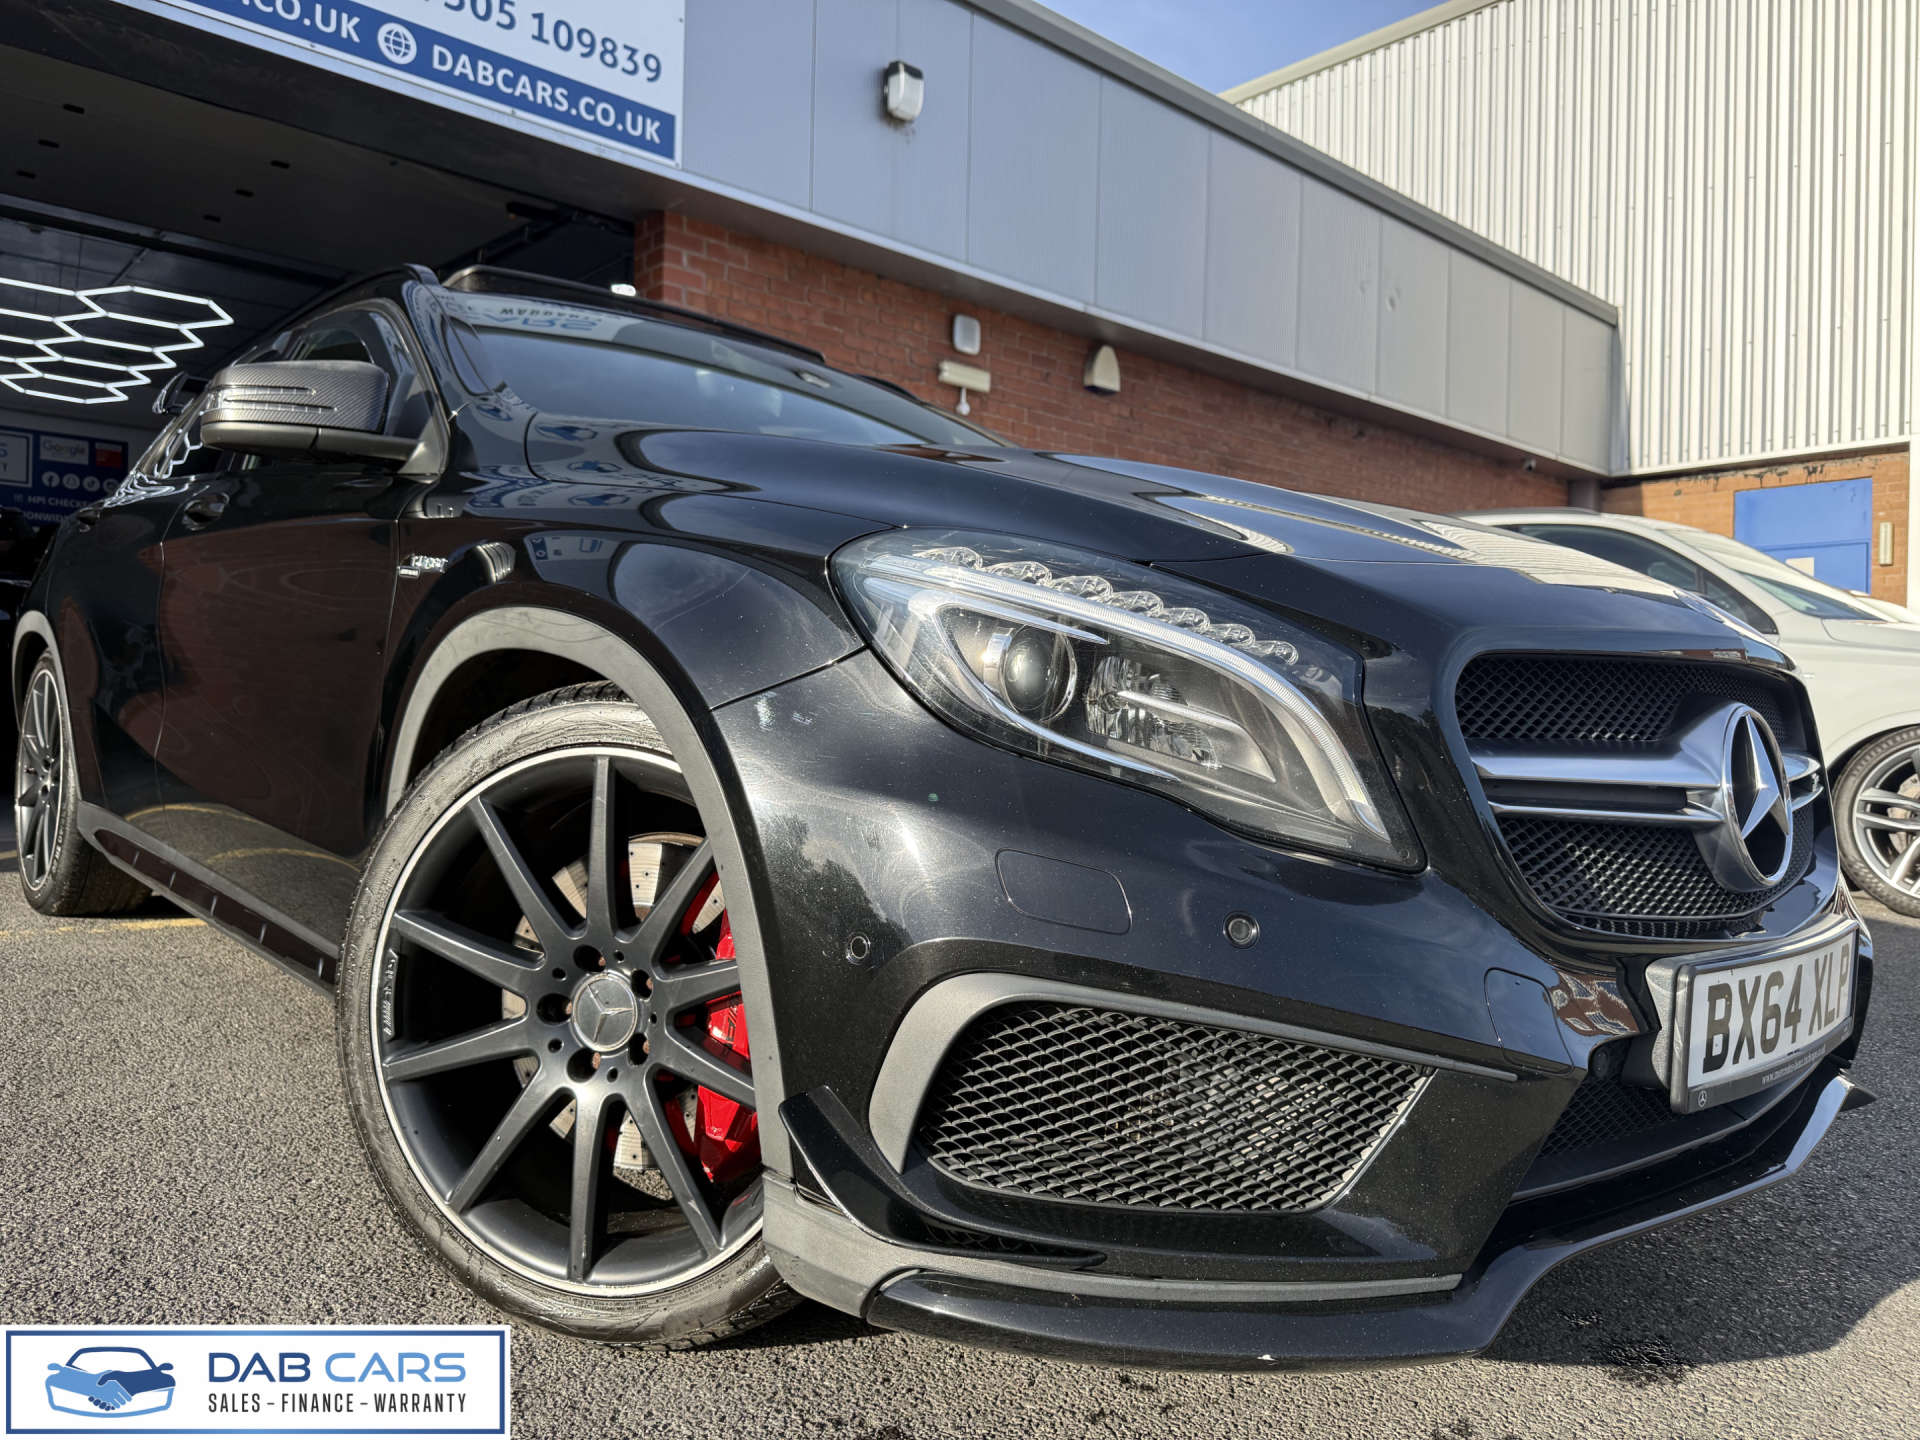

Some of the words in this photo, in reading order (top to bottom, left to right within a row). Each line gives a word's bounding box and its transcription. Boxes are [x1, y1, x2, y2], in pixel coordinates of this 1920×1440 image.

[432, 44, 661, 144] DABCARS.CO.UK
[531, 12, 662, 83] 109839
[1702, 963, 1803, 1075] BX64
[1808, 942, 1850, 1037] XLP
